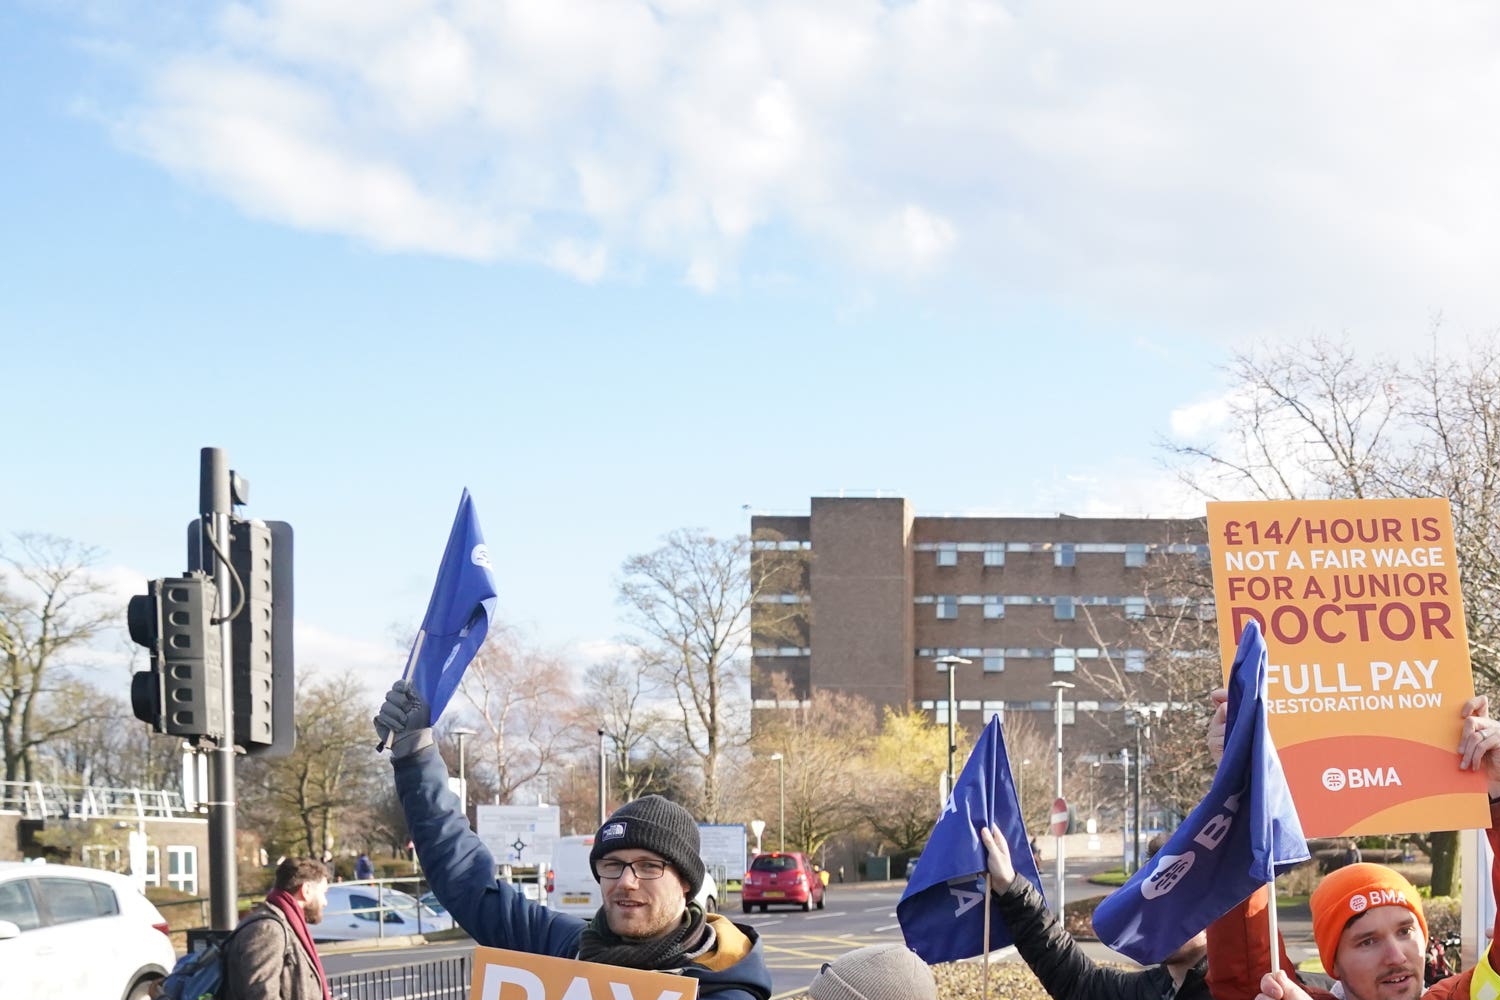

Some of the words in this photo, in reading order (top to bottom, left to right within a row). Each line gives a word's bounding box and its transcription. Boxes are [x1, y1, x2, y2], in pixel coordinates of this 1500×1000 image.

[1224, 517, 1402, 545] £14/HOUR
[1412, 517, 1441, 542] IS
[1225, 551, 1279, 571] NOT
[1286, 549, 1304, 570] A
[1310, 549, 1367, 569] FAIR
[1371, 547, 1445, 568] WAGE
[1228, 576, 1294, 600] FOR
[1303, 575, 1326, 599] A
[1332, 572, 1449, 602] JUNIOR
[1231, 601, 1455, 645] DOCTOR
[1370, 659, 1439, 691] PAY
[1267, 695, 1394, 714] RESTORATION
[1400, 693, 1442, 709] NOW
[1348, 767, 1402, 788] BMA
[1369, 889, 1407, 905] BMA
